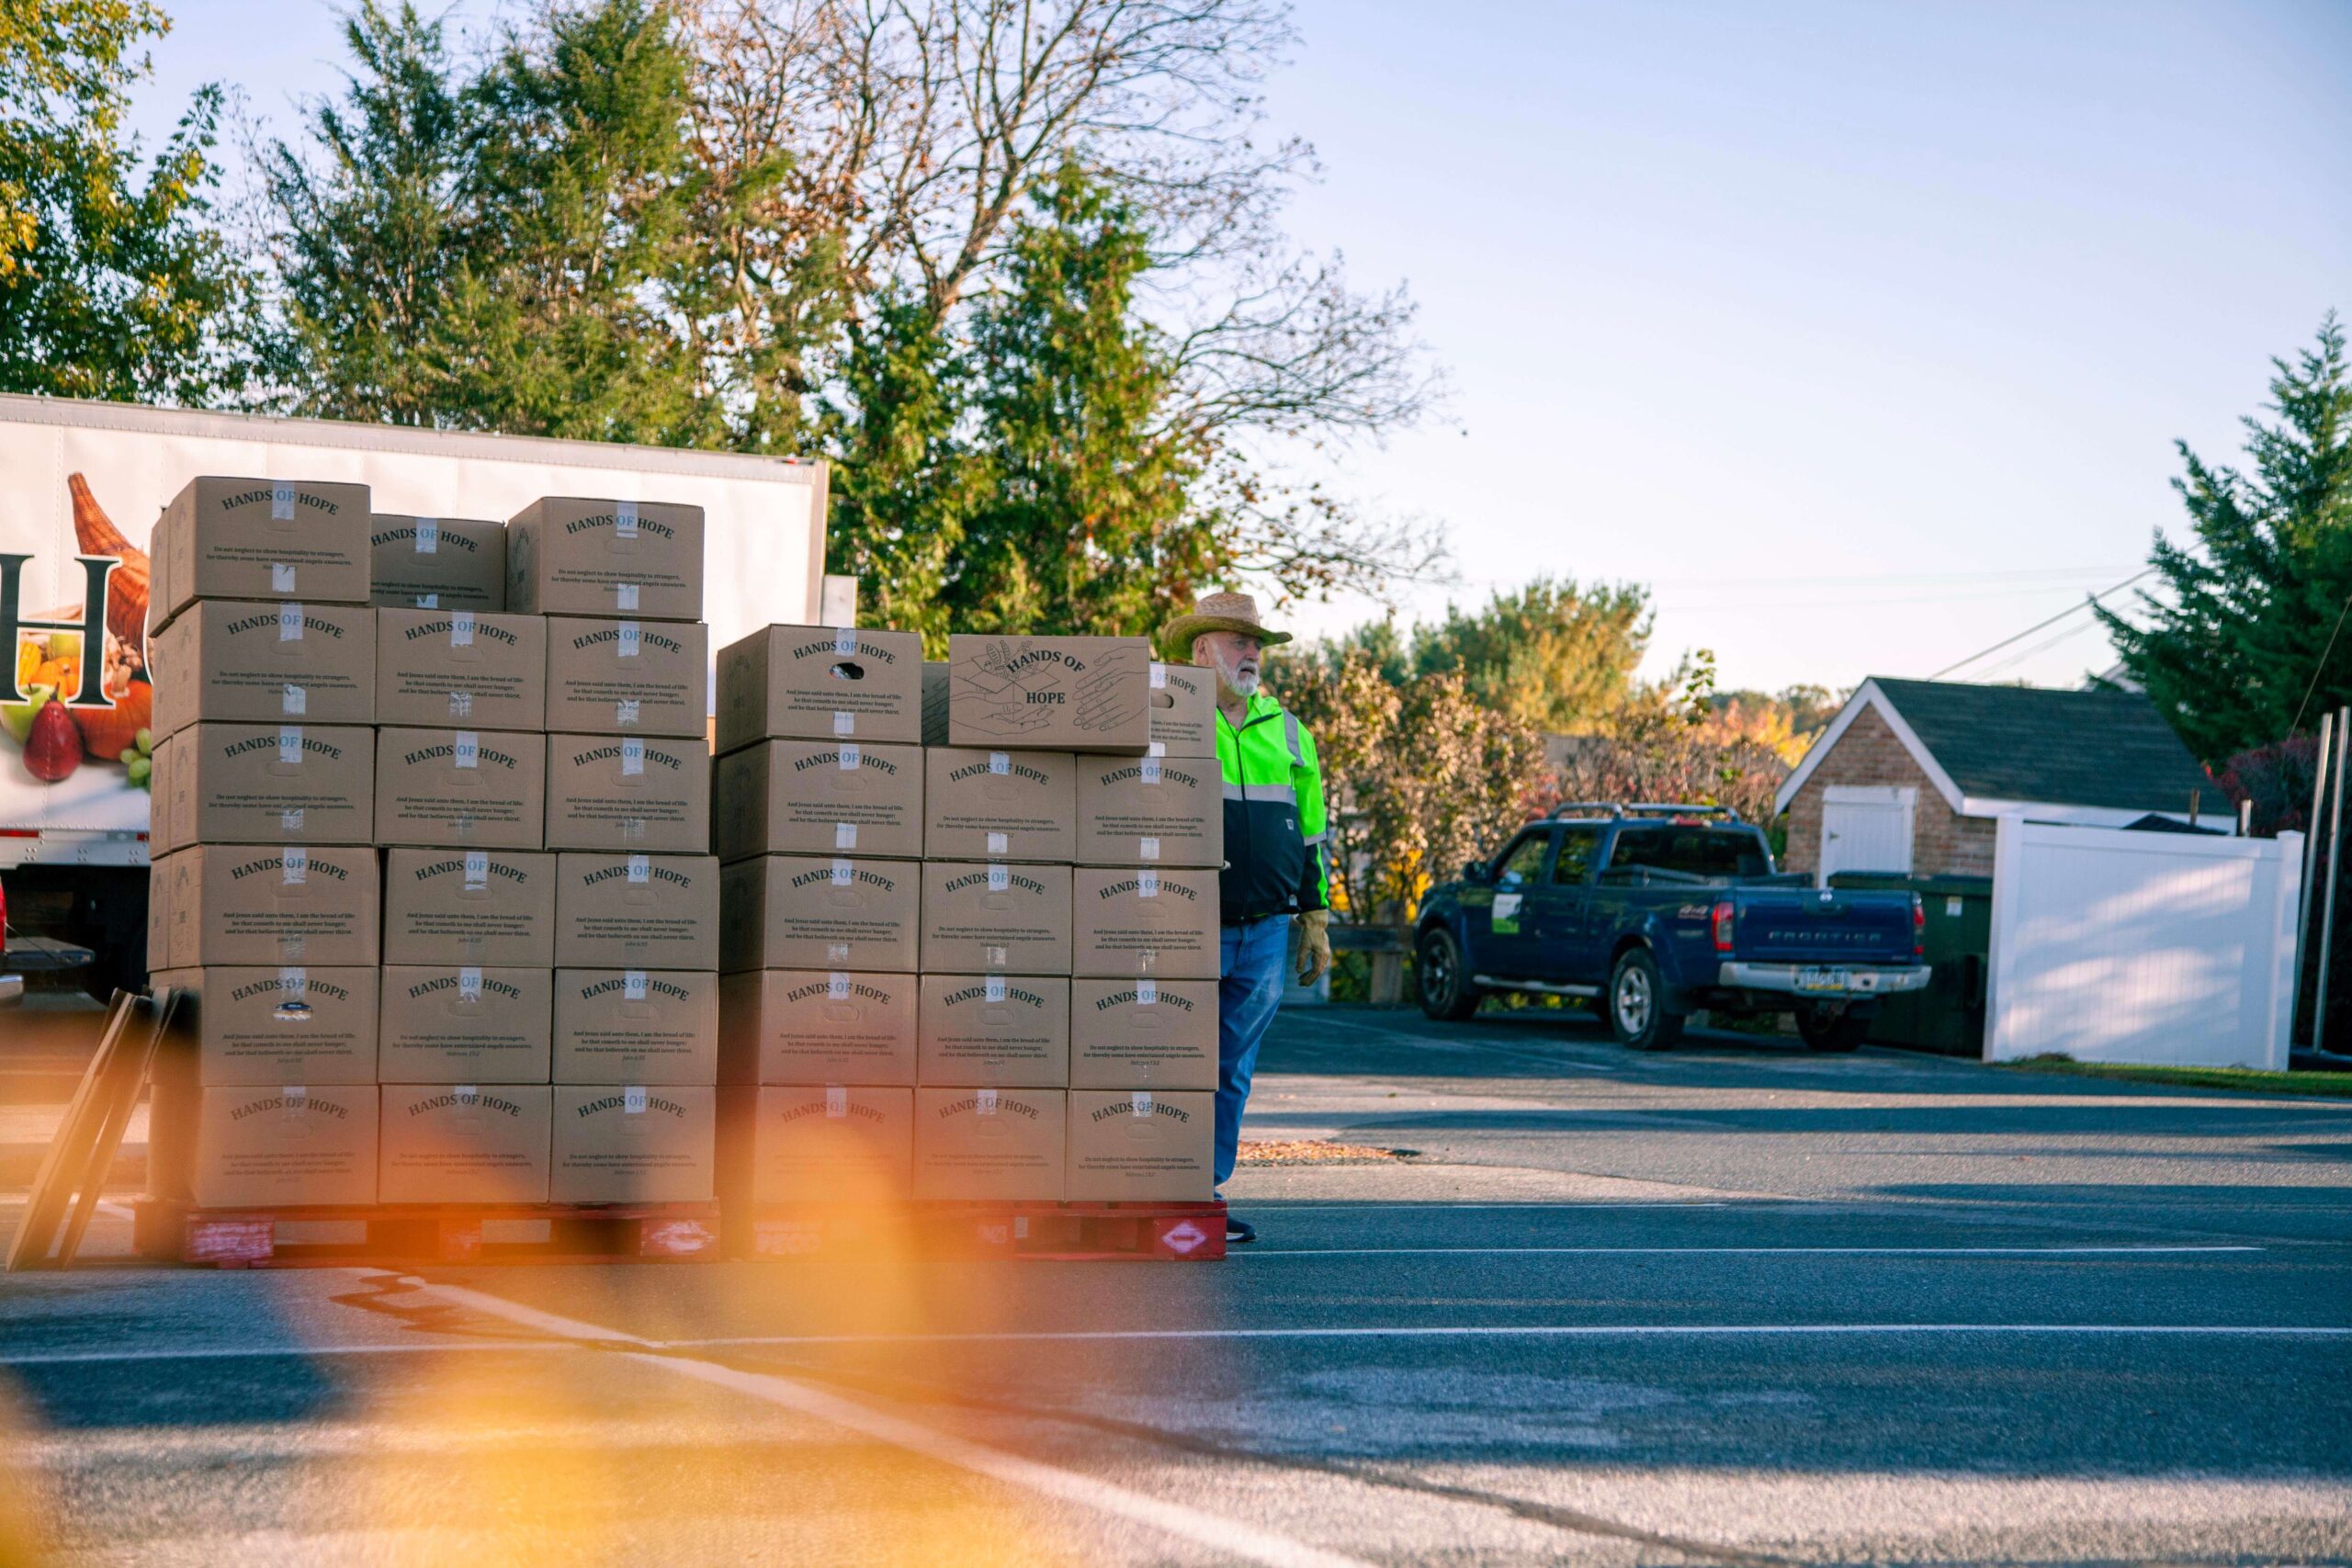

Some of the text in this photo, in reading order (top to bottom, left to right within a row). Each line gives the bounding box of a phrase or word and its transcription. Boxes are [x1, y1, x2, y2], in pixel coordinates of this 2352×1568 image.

[221, 491, 339, 515] HANDS OF HOPE
[566, 515, 674, 539] HANDS OF HOPE
[370, 528, 478, 553] HANDS OF HOPE
[227, 615, 344, 638] HANDS OF HOPE
[405, 621, 517, 646] HANDS OF HOPE
[572, 630, 681, 653] HANDS OF HOPE
[793, 641, 895, 664] HANDS OF HOPE
[1007, 650, 1086, 674] HANDS OF
[1170, 675, 1198, 694] HOPE
[1026, 693, 1066, 704] HOPE
[224, 736, 342, 760] HANDS OF HOPE
[404, 746, 517, 769] HANDS OF HOPE
[573, 747, 681, 770] HANDS OF HOPE
[795, 752, 897, 775] HANDS OF HOPE
[949, 762, 1049, 785] HANDS OF HOPE
[1101, 766, 1198, 788] HANDS OF HOPE
[232, 857, 348, 881] HANDS OF HOPE
[415, 861, 527, 884] HANDS OF HOPE
[583, 865, 691, 888] HANDS OF HOPE
[791, 869, 894, 892] HANDS OF HOPE
[945, 873, 1045, 895] HANDS OF HOPE
[1099, 879, 1197, 901] HANDS OF HOPE
[232, 977, 349, 1001] HANDS OF HOPE
[409, 976, 521, 999] HANDS OF HOPE
[581, 979, 689, 1000] HANDS OF HOPE
[787, 982, 890, 1005] HANDS OF HOPE
[944, 987, 1044, 1008] HANDS OF HOPE
[1096, 990, 1193, 1012] HANDS OF HOPE
[231, 1096, 348, 1121] HANDS OF HOPE
[408, 1094, 521, 1116] HANDS OF HOPE
[578, 1095, 686, 1118] HANDS OF HOPE
[939, 1099, 982, 1118] HANDS
[1005, 1100, 1039, 1120] HOPE
[1091, 1101, 1190, 1123] HANDS OF HOPE
